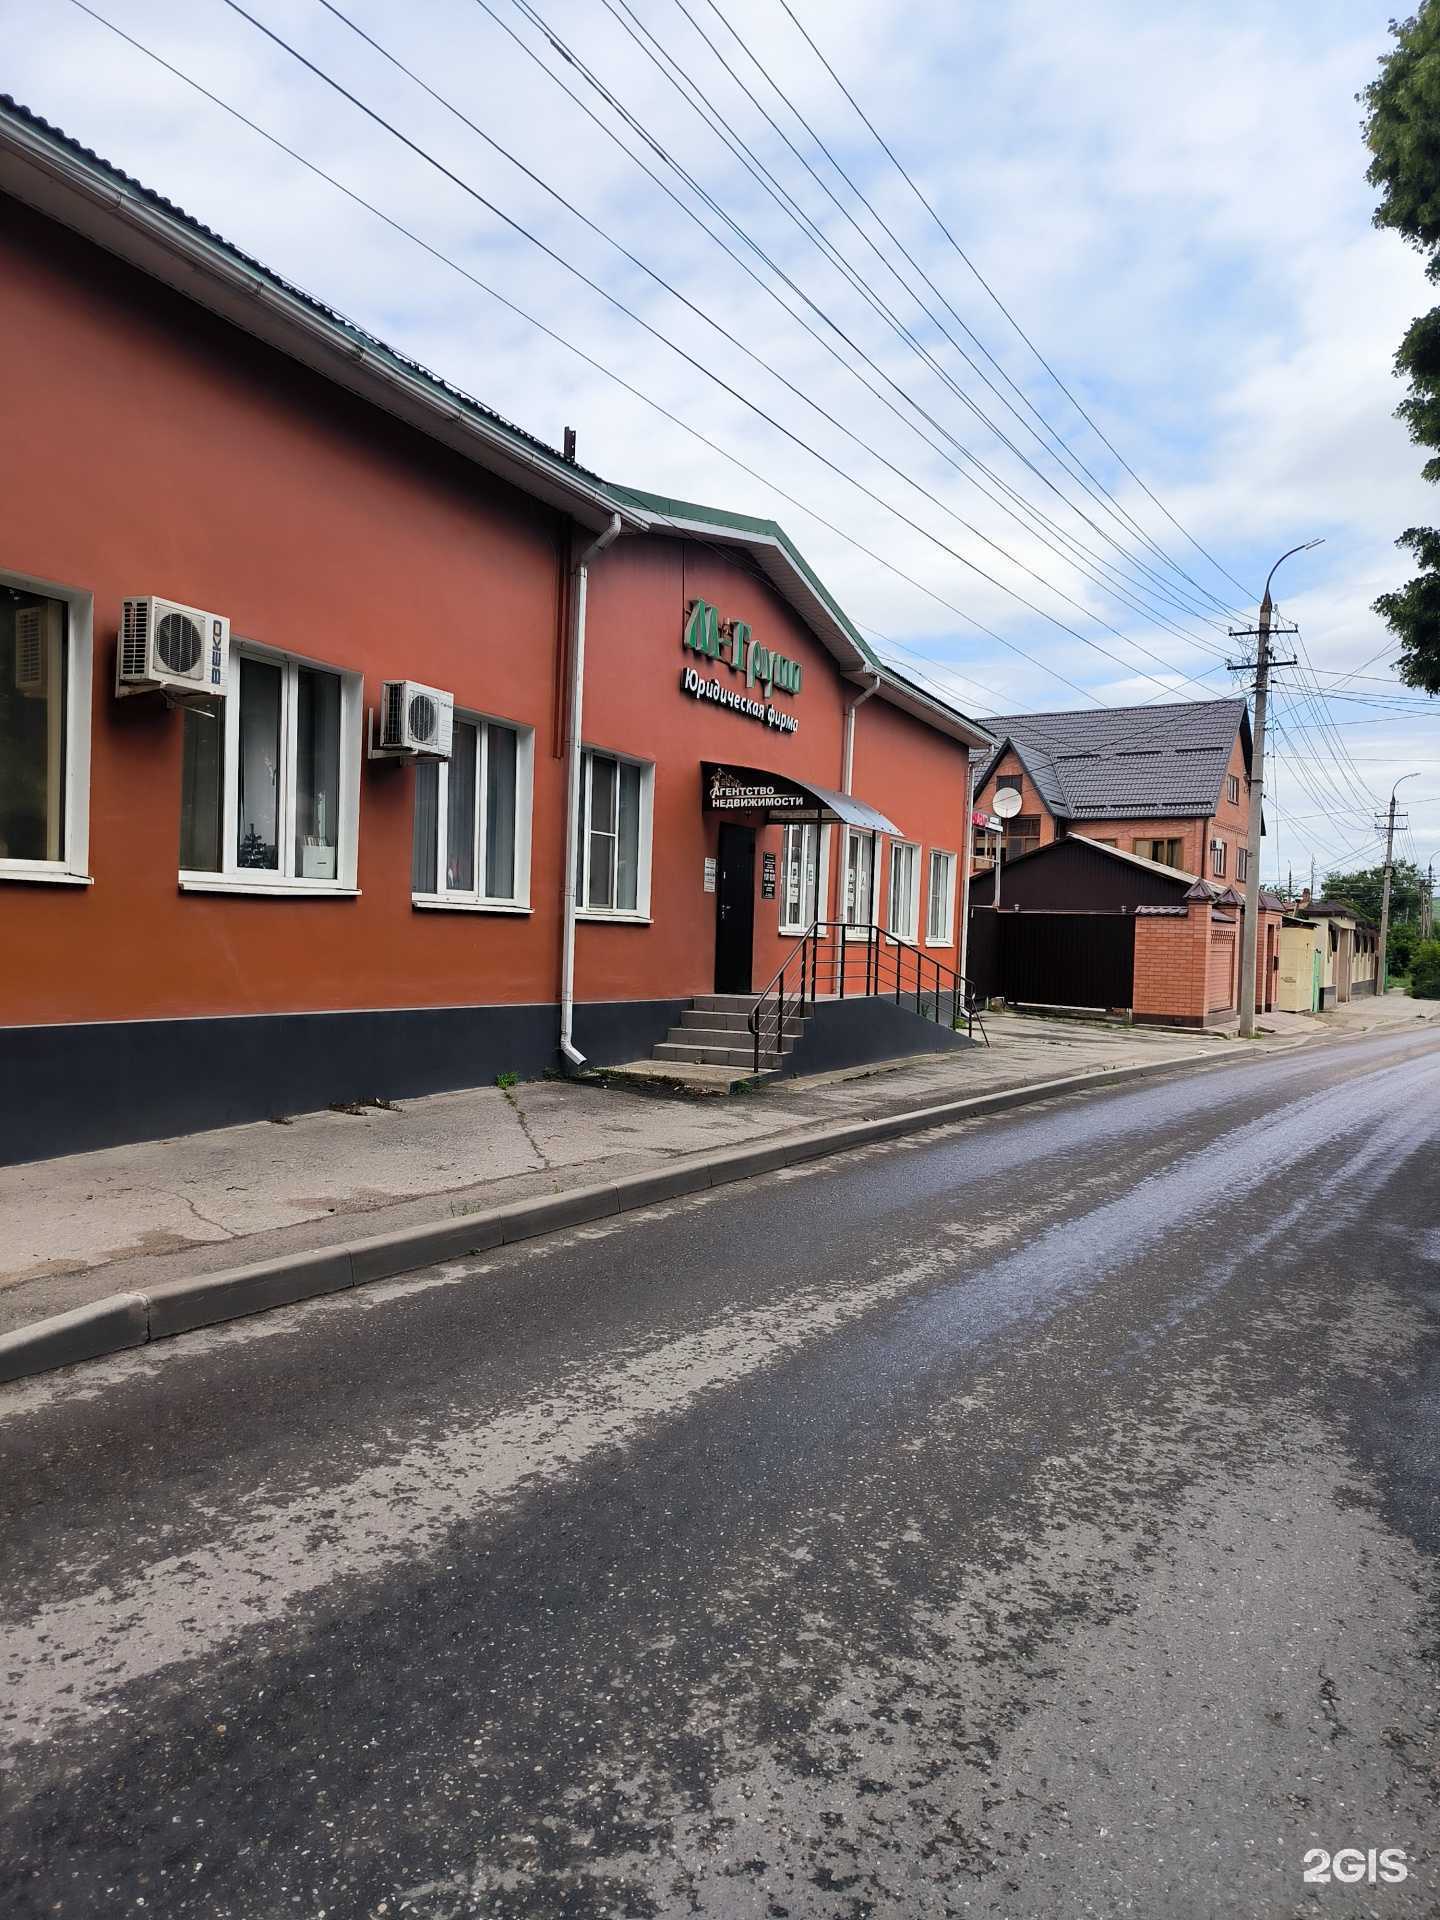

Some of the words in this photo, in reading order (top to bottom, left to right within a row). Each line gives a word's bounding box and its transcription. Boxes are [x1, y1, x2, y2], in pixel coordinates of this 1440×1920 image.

[212, 620, 222, 684] BEKO
[684, 667, 765, 719] Юридическая
[767, 704, 799, 733] фирма
[712, 797, 804, 809] НЕДВИЖИМОСТИ
